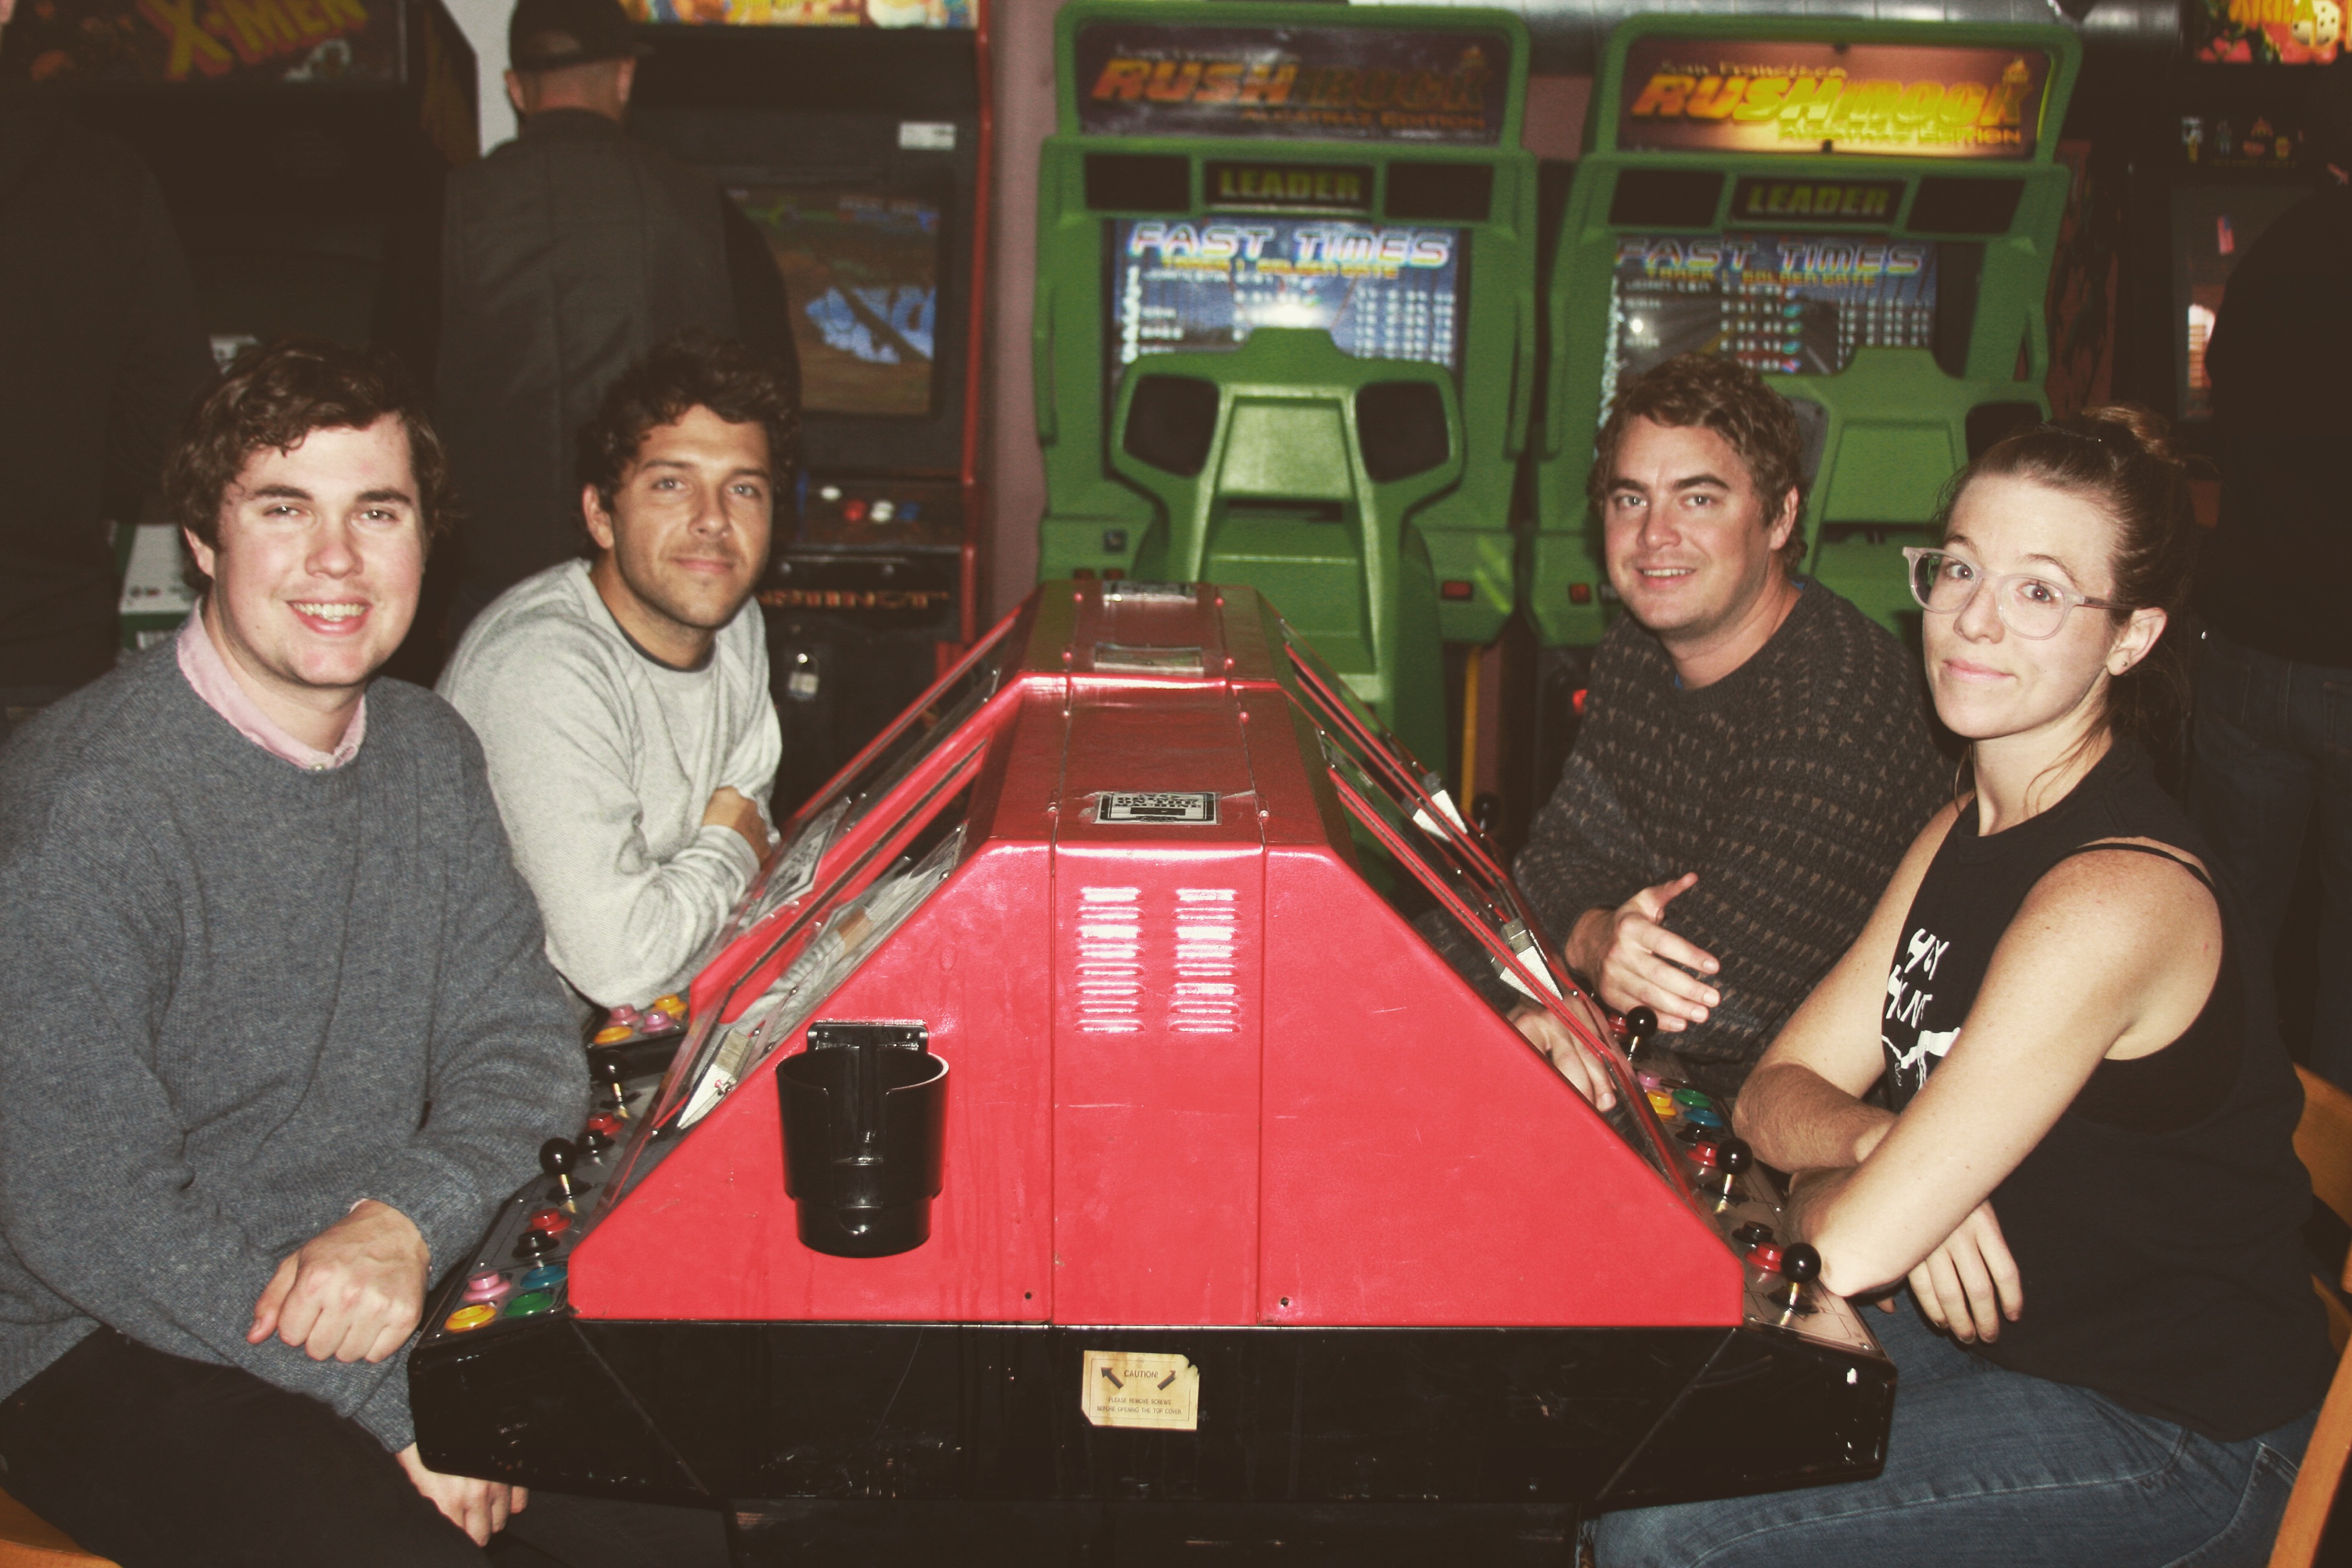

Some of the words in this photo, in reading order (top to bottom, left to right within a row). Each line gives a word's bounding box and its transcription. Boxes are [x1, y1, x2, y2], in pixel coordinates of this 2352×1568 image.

[1090, 57, 1299, 106] RUSH
[1632, 74, 1844, 122] RUSH
[1219, 169, 1360, 201] LEADER
[1745, 184, 1890, 216] LEADER
[1126, 221, 1276, 263] FAST
[1293, 226, 1453, 270] TIMES
[1614, 239, 1756, 272] FAST
[1776, 240, 1925, 276] TIMES
[1124, 1370, 1158, 1378] CAUTION!
